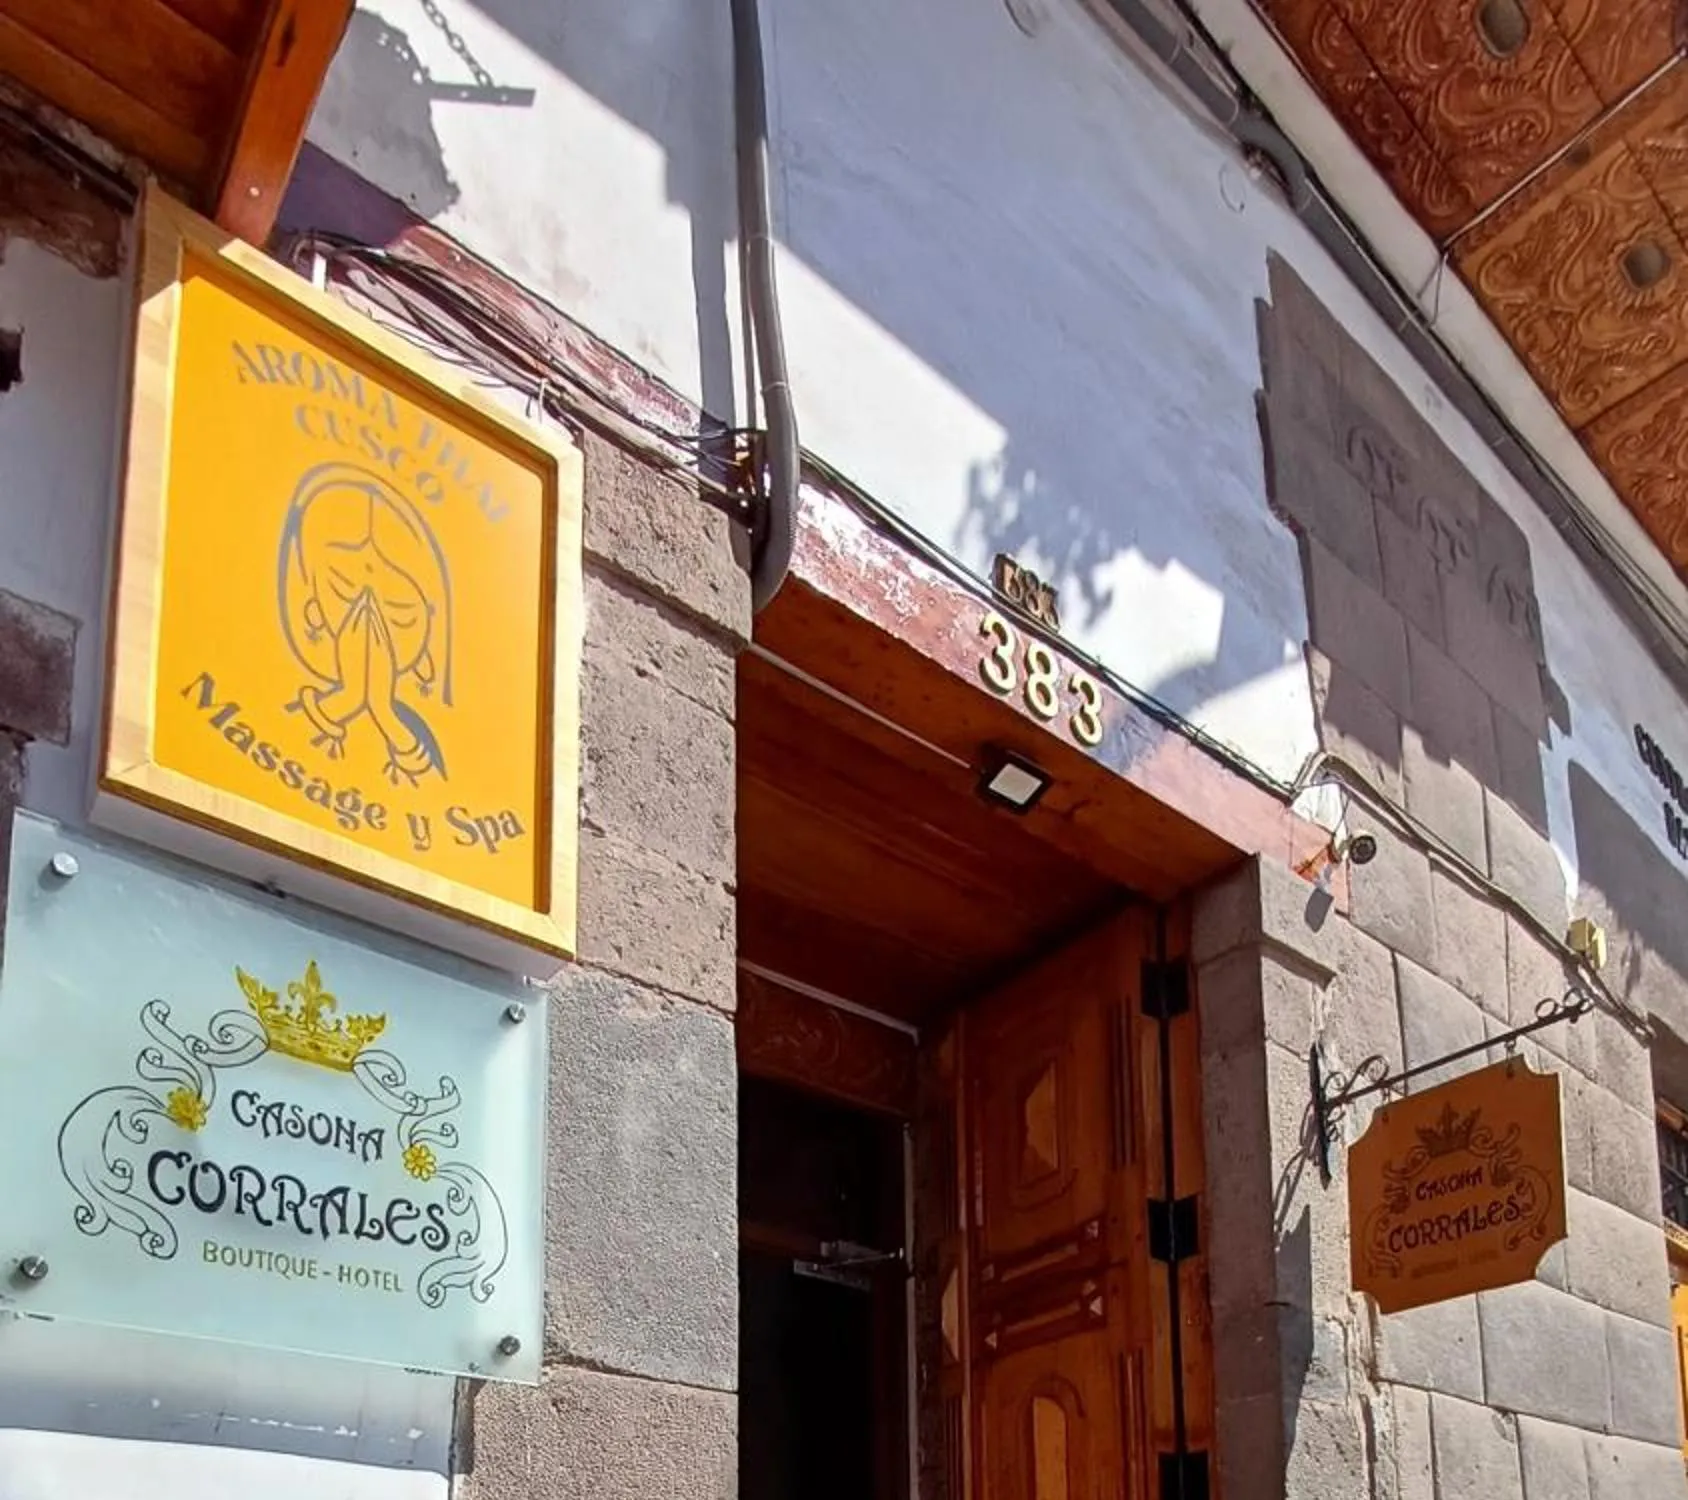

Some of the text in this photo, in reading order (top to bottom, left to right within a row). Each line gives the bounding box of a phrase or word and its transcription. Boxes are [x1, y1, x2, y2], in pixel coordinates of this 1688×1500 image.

[231, 339, 398, 431] AROMA
[295, 403, 443, 506] CUSCO
[978, 612, 1103, 748] 383
[180, 670, 526, 854] Massage y Spa
[230, 1088, 386, 1165] CASONA
[147, 1150, 451, 1252] CORRALES
[1388, 1196, 1521, 1254] CORRALES
[1415, 1166, 1483, 1201] CASONA
[202, 1240, 319, 1281] BOUTIQUE
[338, 1264, 404, 1294] HOTEL
